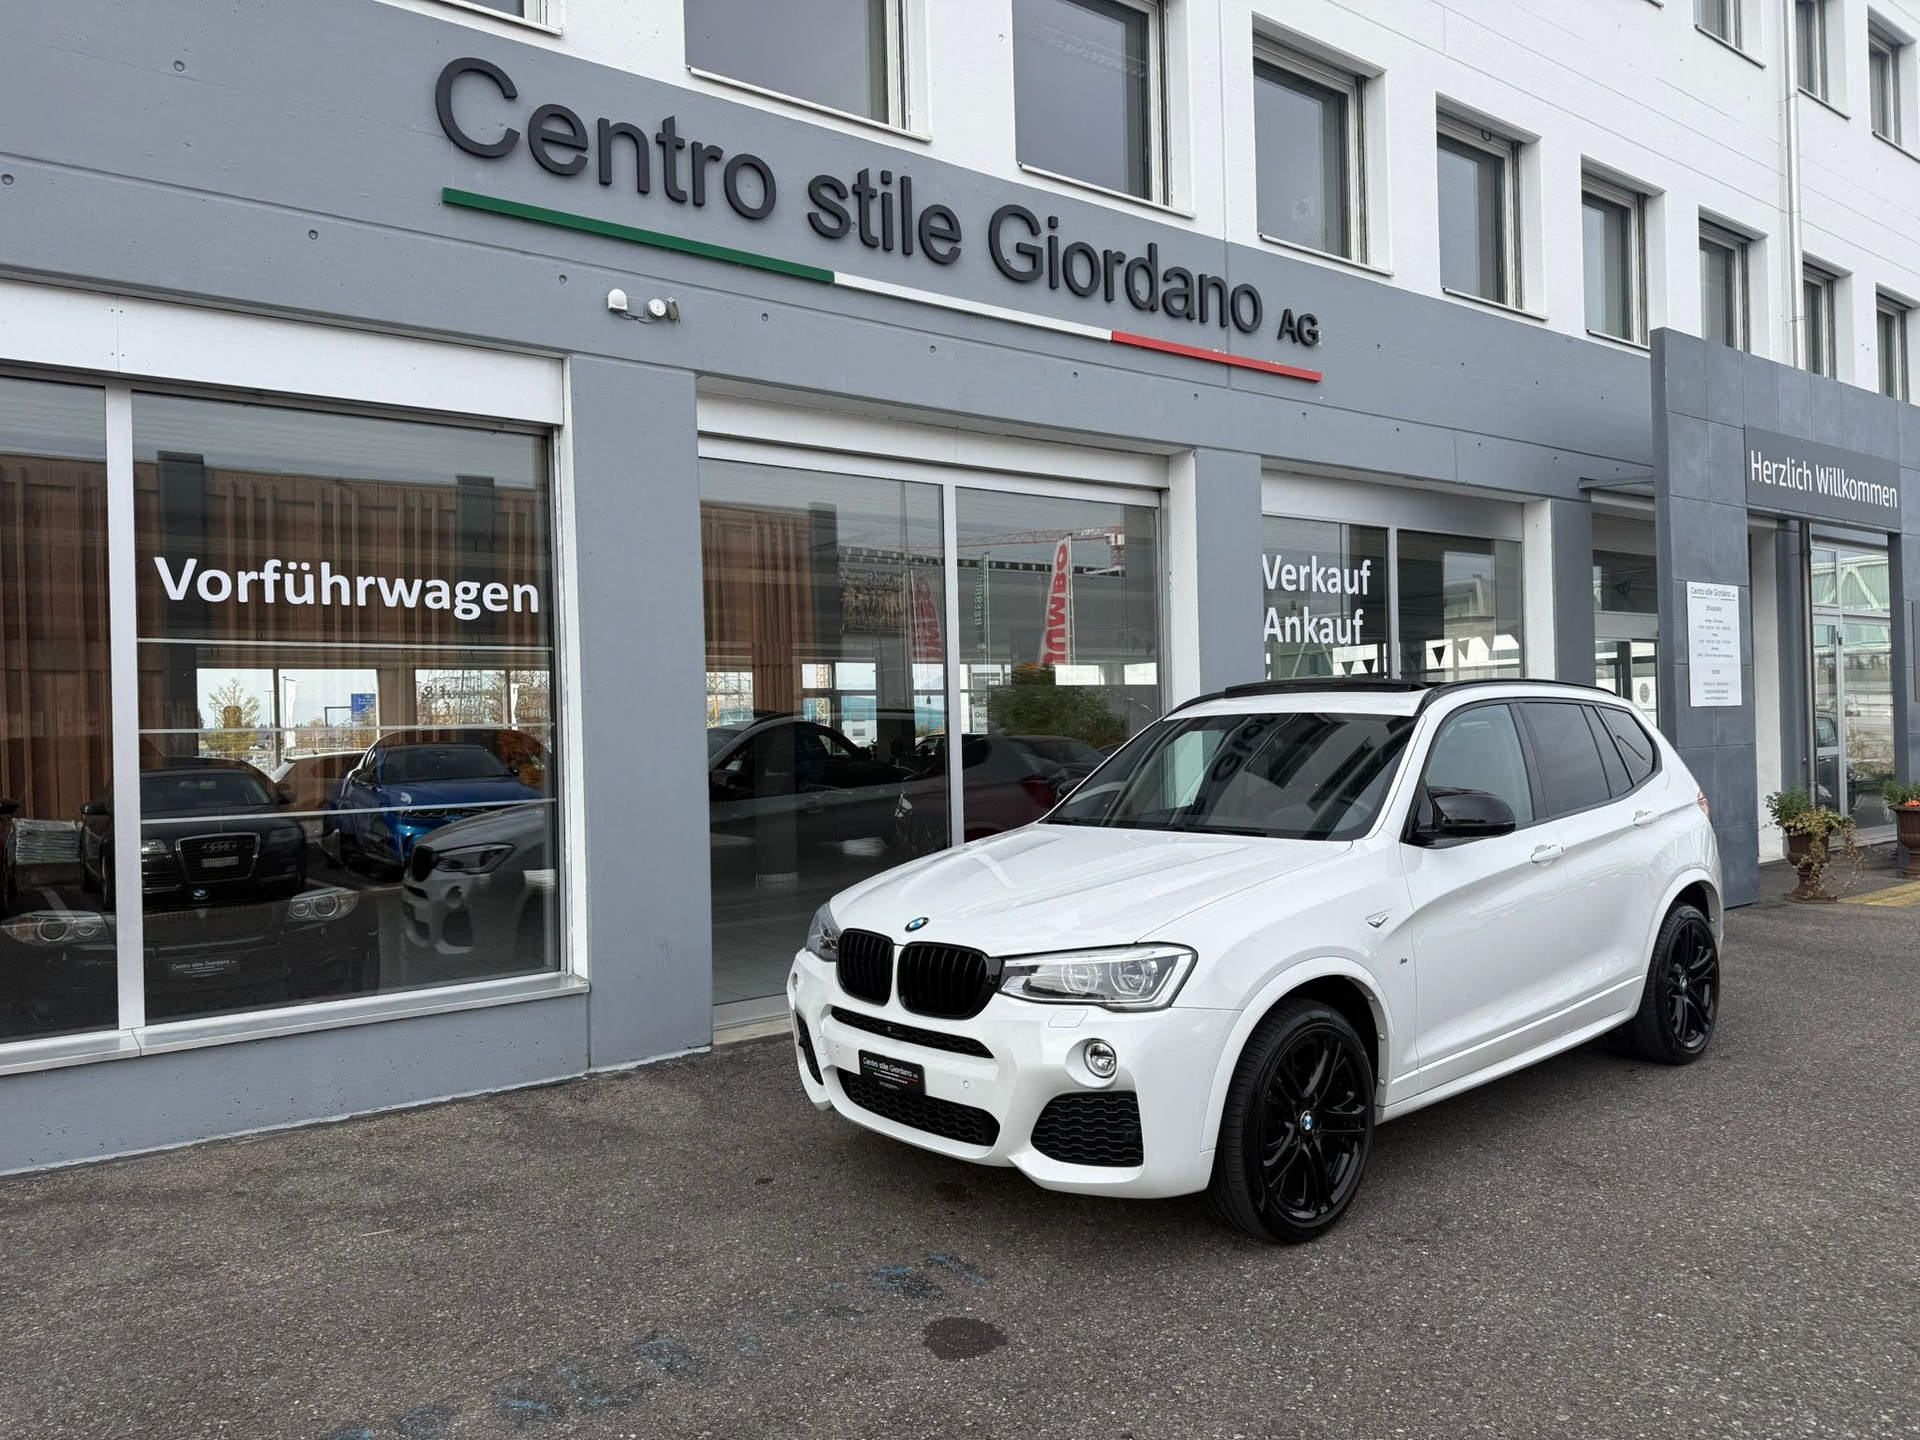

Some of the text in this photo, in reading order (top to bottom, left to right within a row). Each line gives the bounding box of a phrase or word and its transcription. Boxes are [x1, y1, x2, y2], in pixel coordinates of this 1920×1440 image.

[435, 57, 1320, 347] Centro stile Giordano AG
[1750, 450, 1898, 509] Herzlich Willkommen
[153, 556, 540, 622] Vorführwagen
[1262, 554, 1371, 595] Verkauf
[1264, 606, 1364, 645] Ankauf
[862, 1057, 878, 1068] Centro
[879, 1062, 889, 1071] stile
[889, 1064, 913, 1077] Giordano
